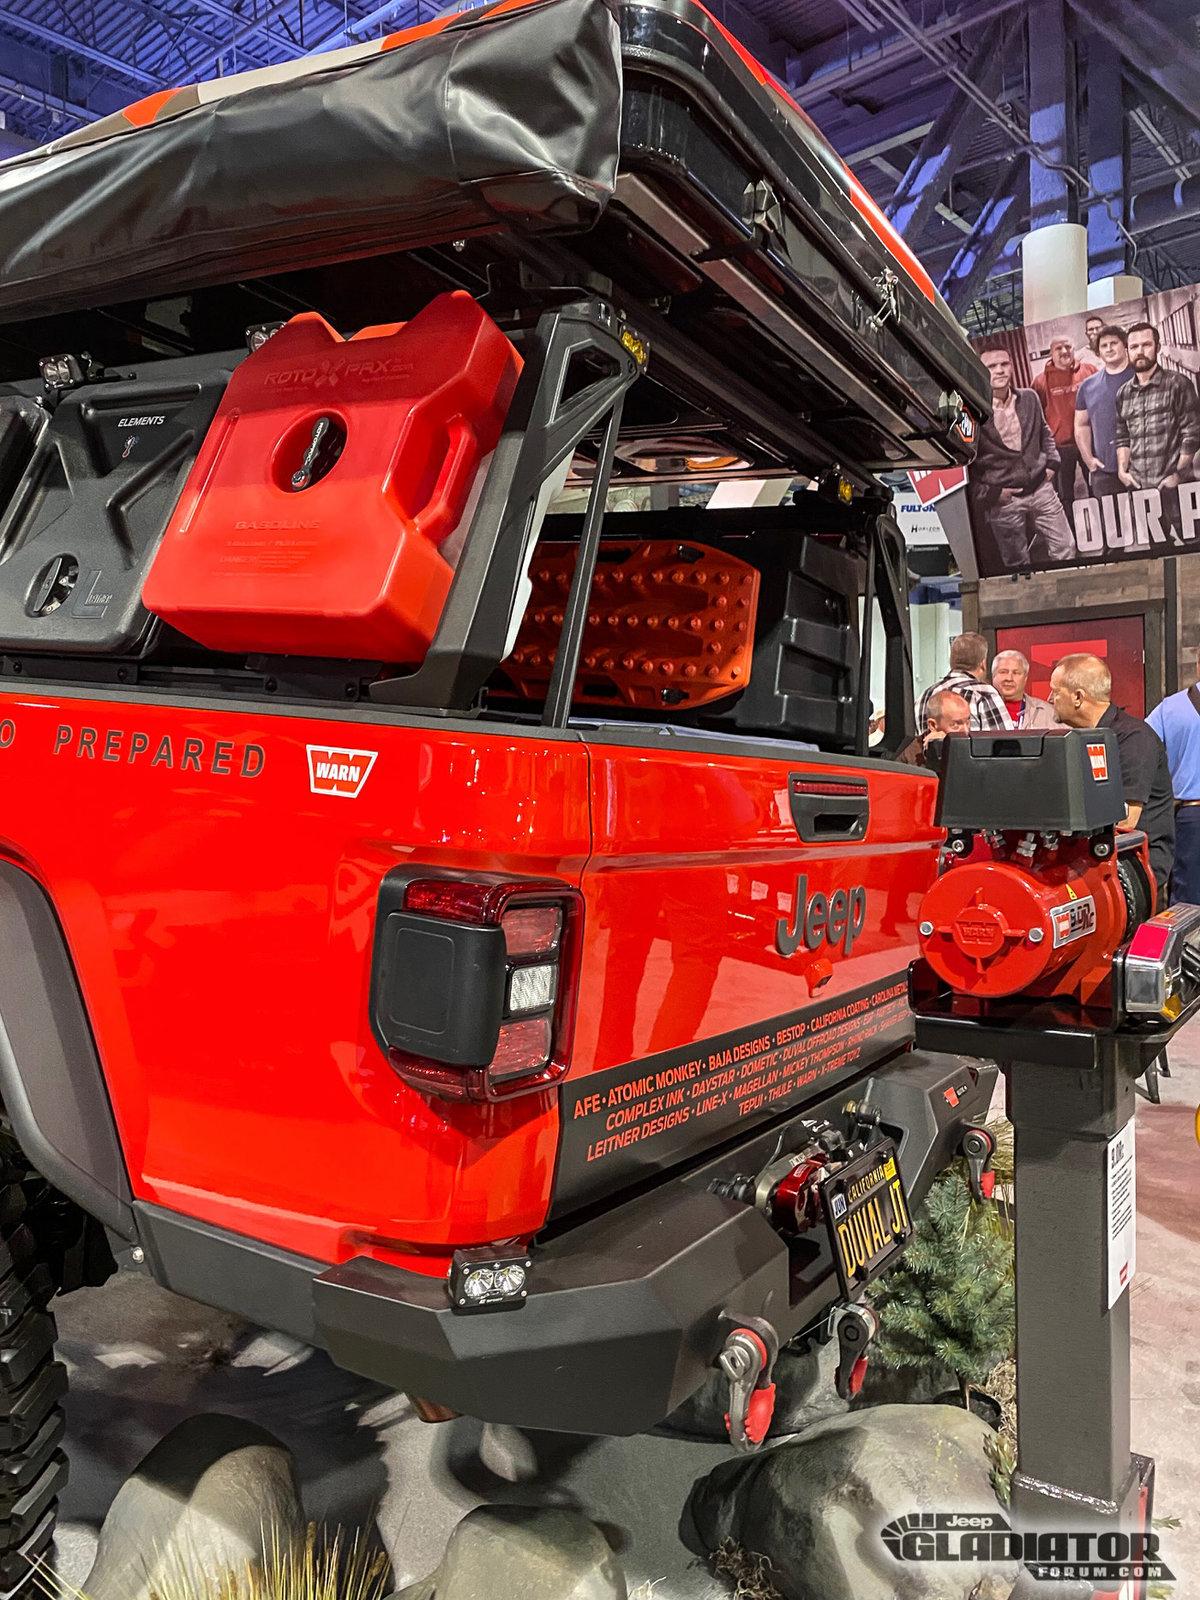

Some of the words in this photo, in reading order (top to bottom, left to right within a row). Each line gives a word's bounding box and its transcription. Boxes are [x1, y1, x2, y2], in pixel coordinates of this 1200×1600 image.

[118, 415, 166, 427] ELEMENTS
[234, 520, 321, 531] GASOLINE
[1072, 488, 1167, 552] OUR
[52, 724, 266, 779] PREPARED
[315, 761, 361, 783] WARN
[776, 873, 867, 957] Jeep
[573, 1093, 601, 1120] AFE
[608, 1075, 655, 1108] ATOMIC
[655, 1059, 702, 1090] MONKEY
[708, 1049, 733, 1072] BAJA
[733, 1035, 771, 1062] DESIGNS
[776, 1022, 806, 1046] BESTOP
[810, 1006, 847, 1032] CALIFORNIA
[606, 1095, 664, 1131] COMPLEX
[665, 1087, 686, 1108] INK
[691, 1068, 736, 1099] DAYSTAR
[741, 1051, 779, 1079] DOMETIC
[782, 1040, 806, 1061] DUVAL
[587, 1126, 640, 1162] LEITNER
[640, 1106, 690, 1140] DESIGNS
[696, 1090, 729, 1117] LINE-X
[733, 1069, 779, 1100] MAGELLAN
[782, 1055, 809, 1078] MICKEY
[738, 1093, 764, 1117] TEPUI
[768, 1080, 793, 1102] THULE
[847, 1164, 885, 1203] CALIFORNIA
[838, 1197, 892, 1278] DUVAL
[889, 1178, 908, 1234] JT
